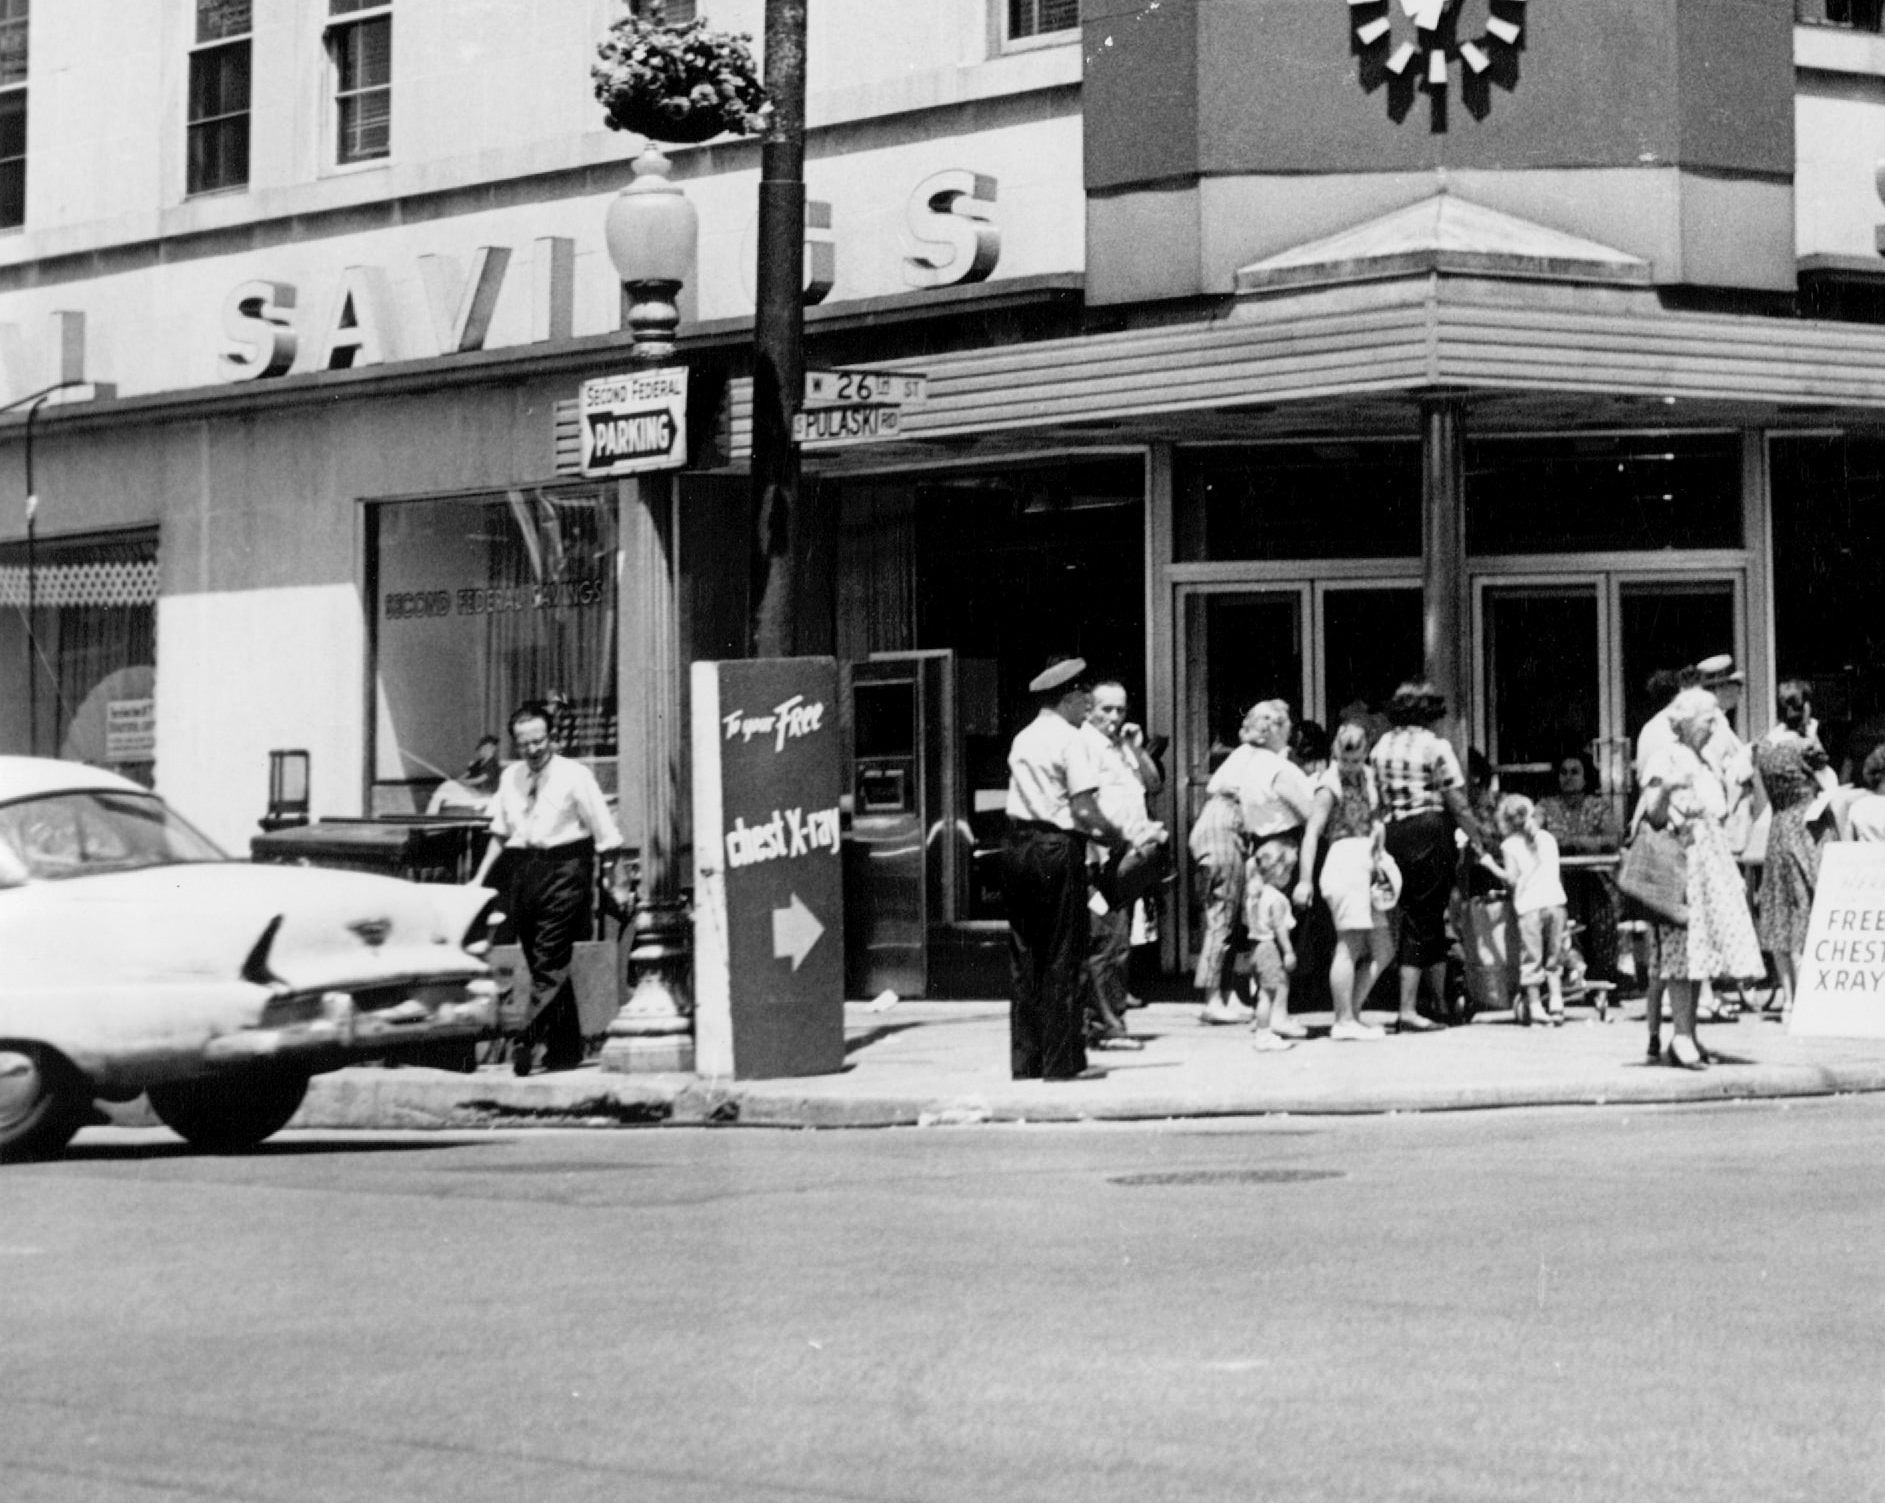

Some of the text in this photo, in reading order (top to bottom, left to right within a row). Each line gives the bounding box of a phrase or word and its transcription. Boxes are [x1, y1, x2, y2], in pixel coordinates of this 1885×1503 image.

[586, 377, 682, 407] SECOND FEDERAL
[811, 378, 822, 393] W
[903, 380, 921, 397] ST
[594, 414, 671, 458] PARKING
[805, 405, 879, 438] PULASKI
[880, 411, 899, 430] RD
[722, 709, 744, 740] To
[741, 715, 777, 744] your
[725, 806, 840, 868] chest X-ray
[1813, 968, 1885, 993] XRAY
